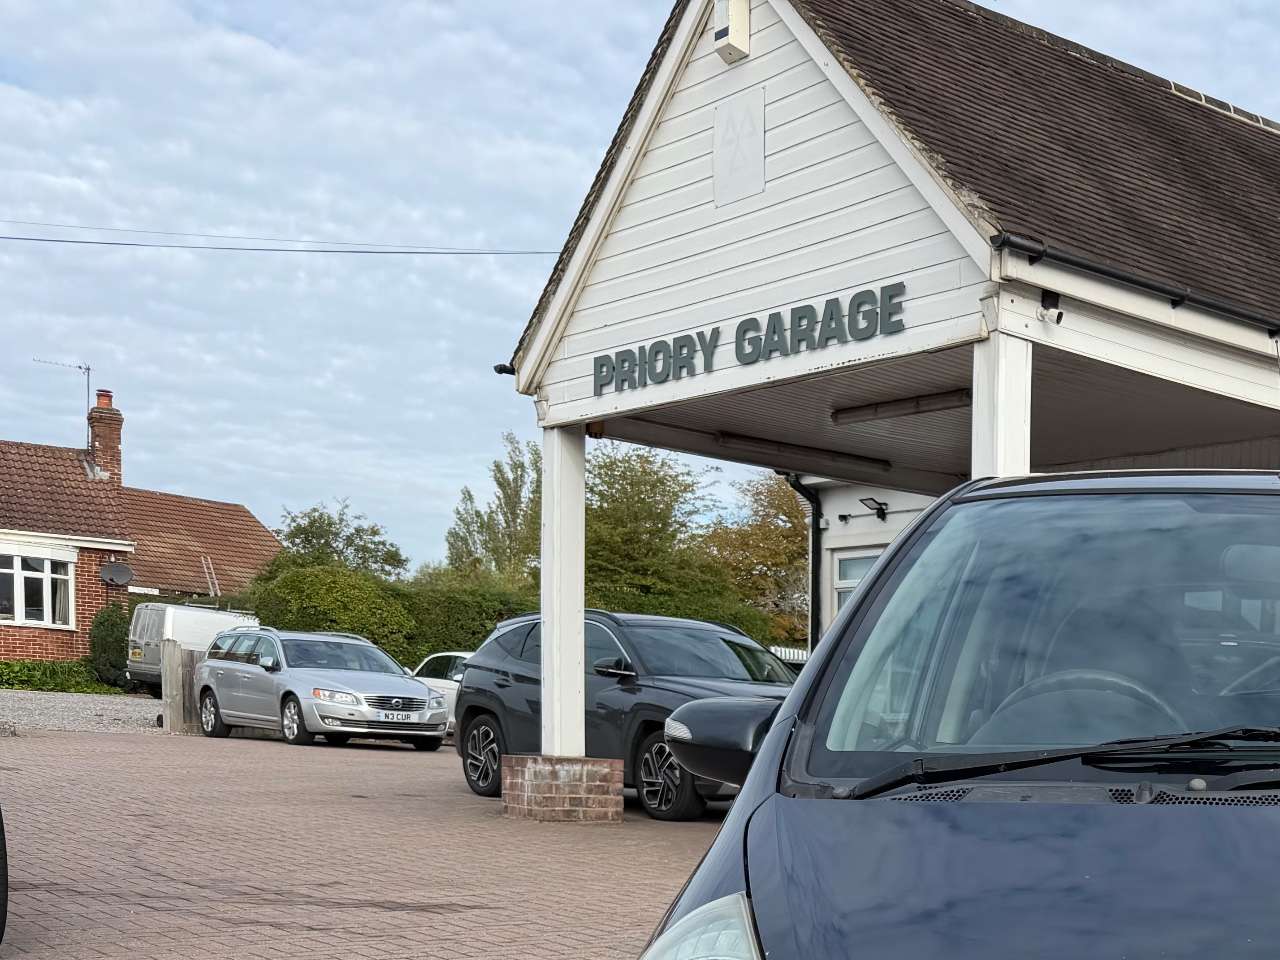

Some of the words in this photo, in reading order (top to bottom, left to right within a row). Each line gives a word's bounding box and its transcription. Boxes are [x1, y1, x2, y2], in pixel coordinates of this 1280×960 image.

[593, 327, 721, 397] PRIORY
[735, 281, 906, 366] GARAGE
[384, 712, 395, 721] N3
[396, 713, 412, 721] CUR
